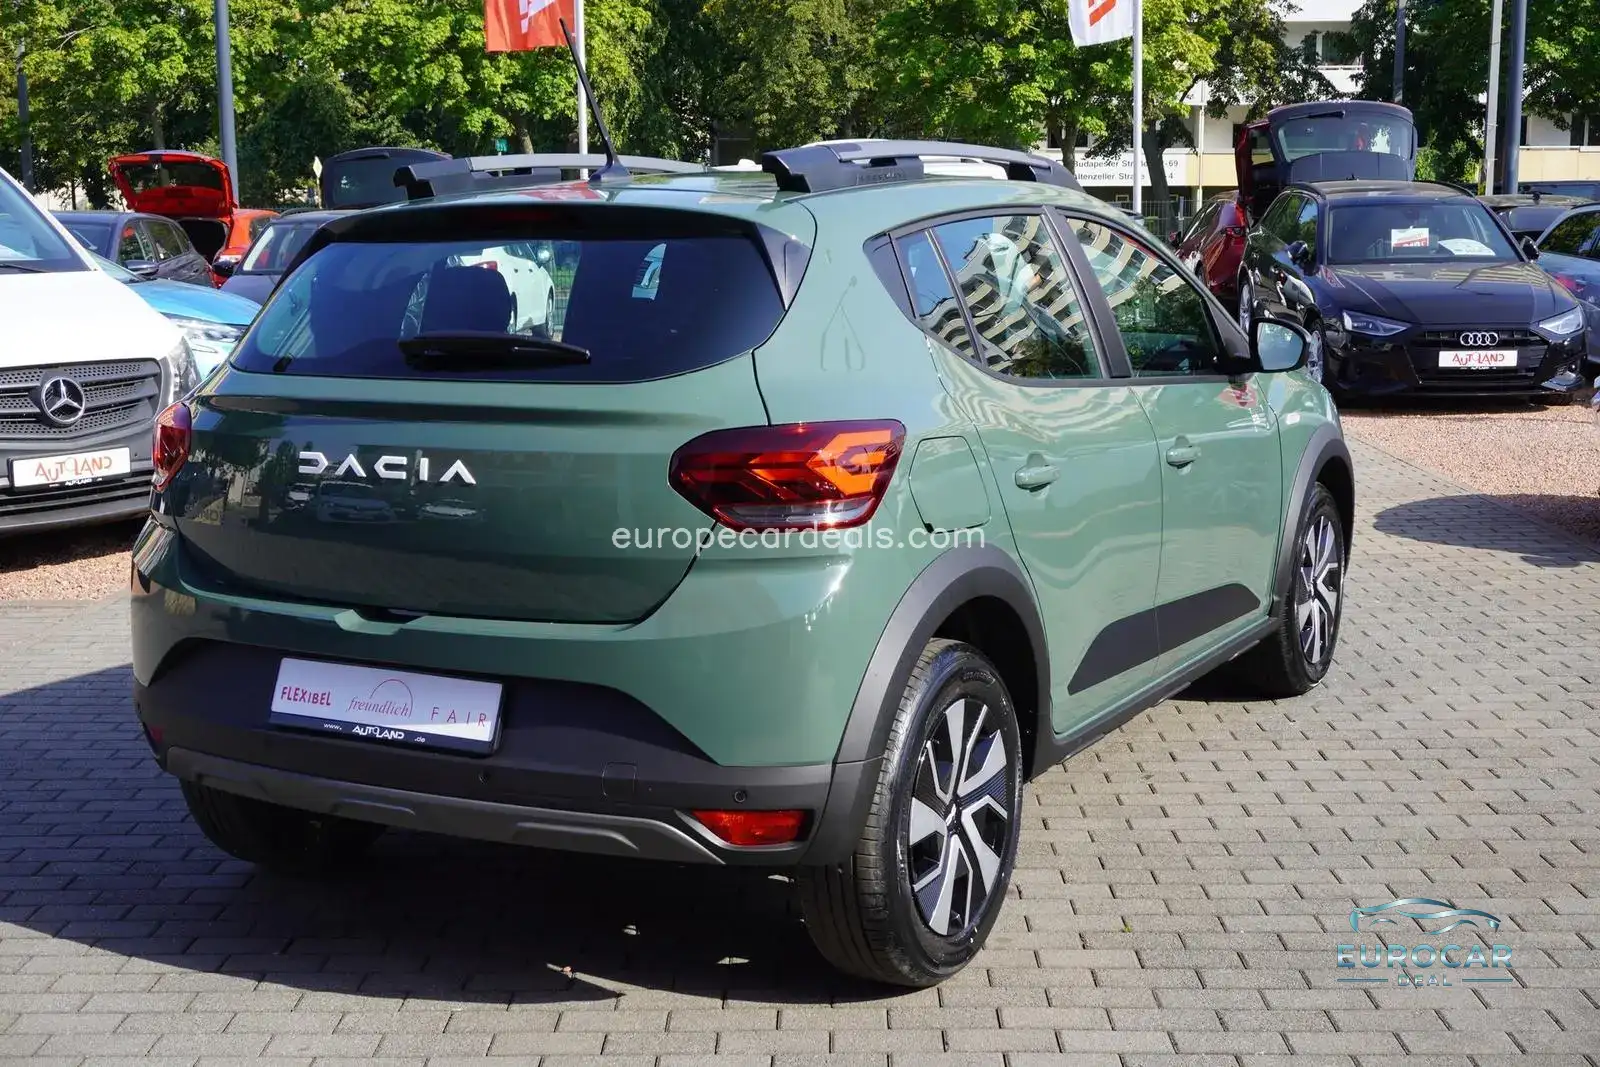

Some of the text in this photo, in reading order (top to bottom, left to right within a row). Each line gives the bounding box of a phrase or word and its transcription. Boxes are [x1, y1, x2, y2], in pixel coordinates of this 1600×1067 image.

[1452, 352, 1505, 365] AUTOLAND
[35, 456, 112, 481] AUTOLAND
[298, 451, 477, 485] DACIA
[280, 686, 332, 706] FLEXIBEL
[348, 697, 410, 718] freundlich
[351, 724, 405, 740] AUTOLAND
